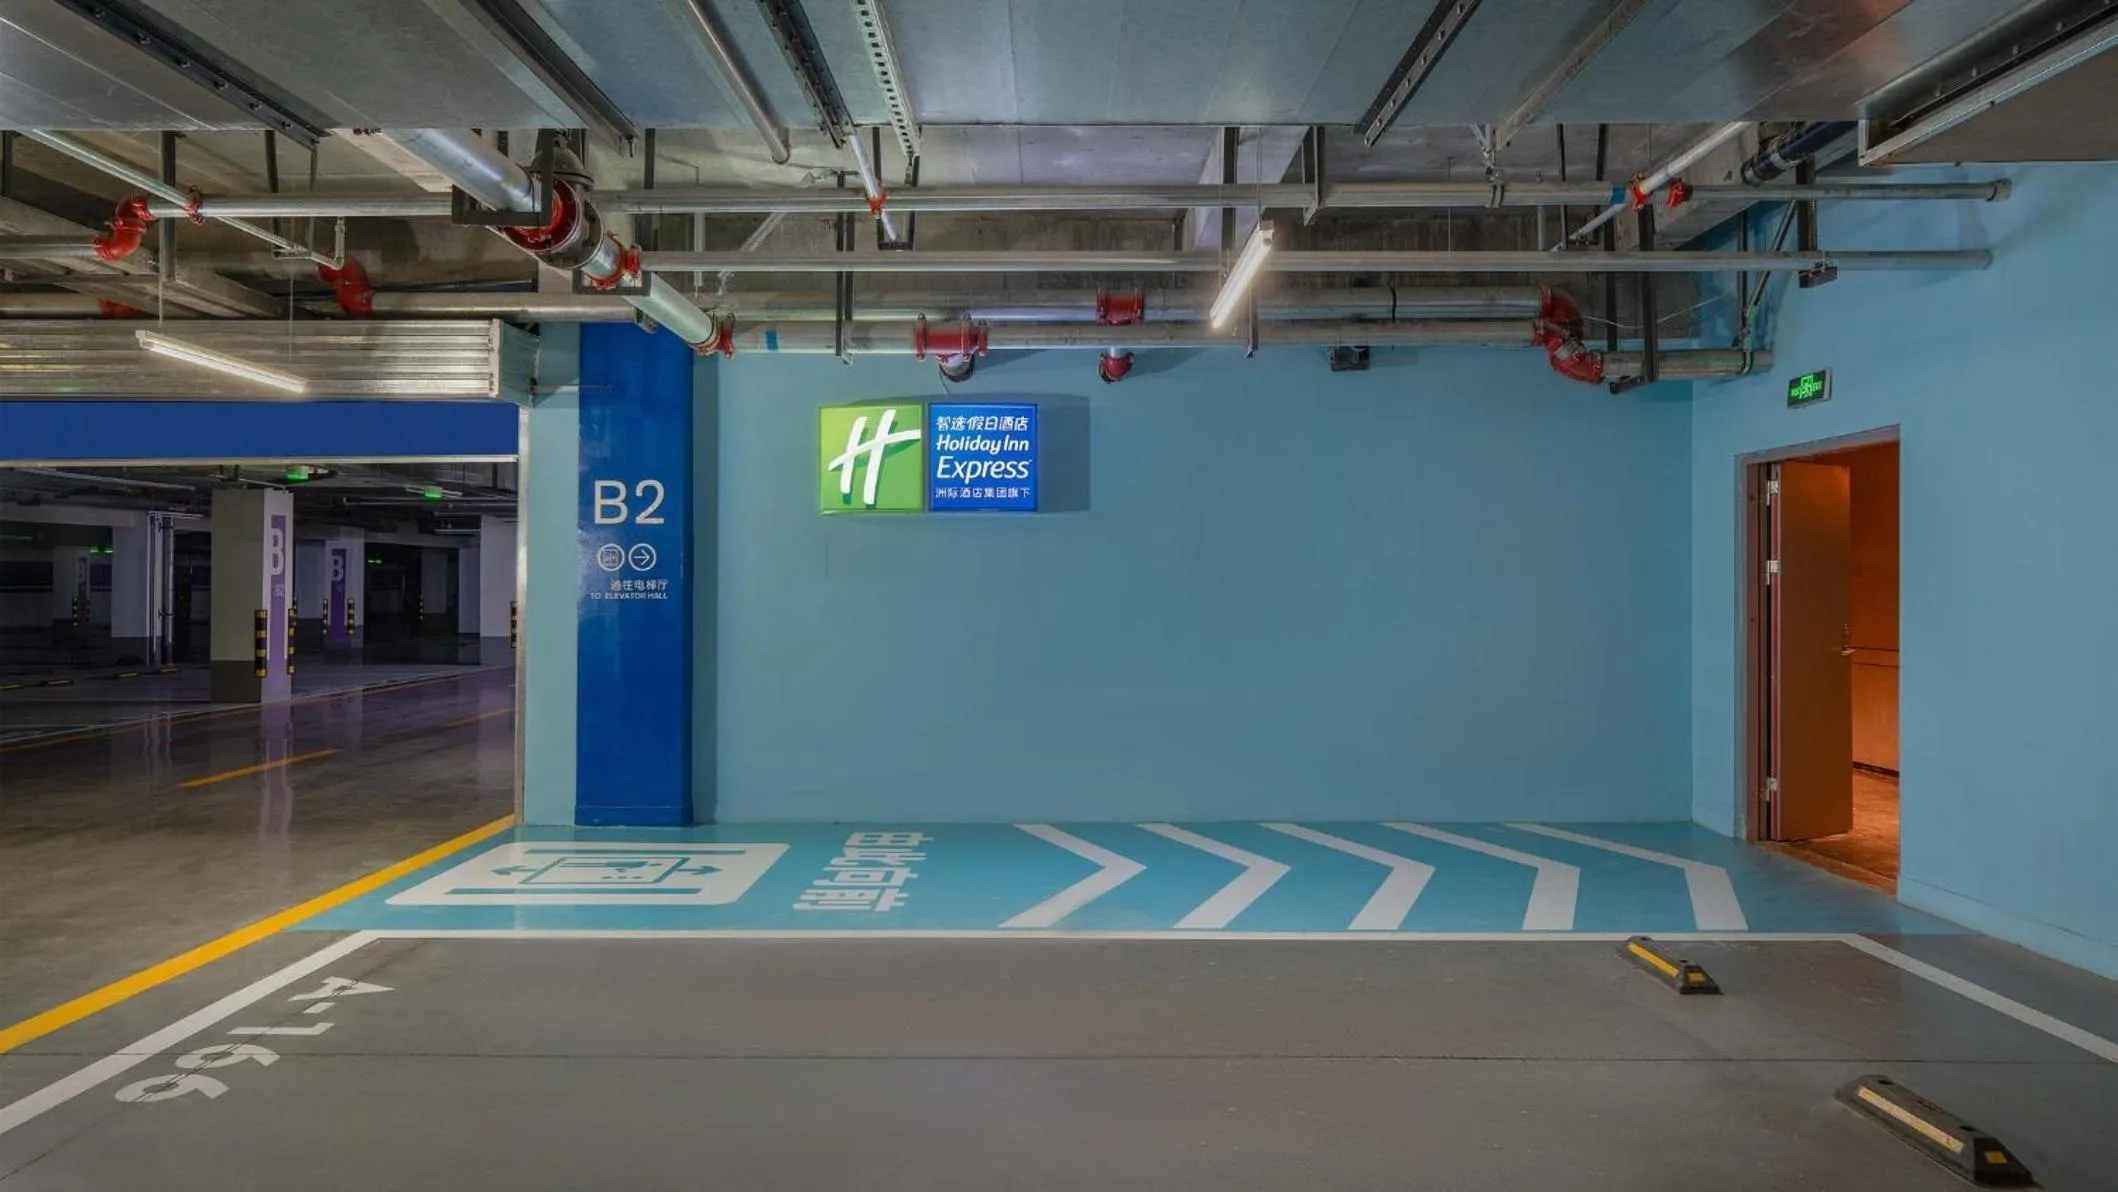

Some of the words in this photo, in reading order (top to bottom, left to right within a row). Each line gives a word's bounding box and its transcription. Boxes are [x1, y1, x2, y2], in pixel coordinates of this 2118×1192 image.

[936, 416, 1028, 431] 智选假日酒店
[828, 409, 921, 504] H
[936, 435, 1000, 454] Holiday
[1004, 435, 1029, 451] Inn
[937, 456, 1030, 483] Express
[594, 479, 665, 524] B2
[935, 487, 1030, 499] 洲际酒店集团旗下
[271, 528, 284, 575] B
[611, 579, 668, 591] 通往电梯厅
[792, 832, 934, 912] 由此向前
[114, 976, 396, 1103] A-166
